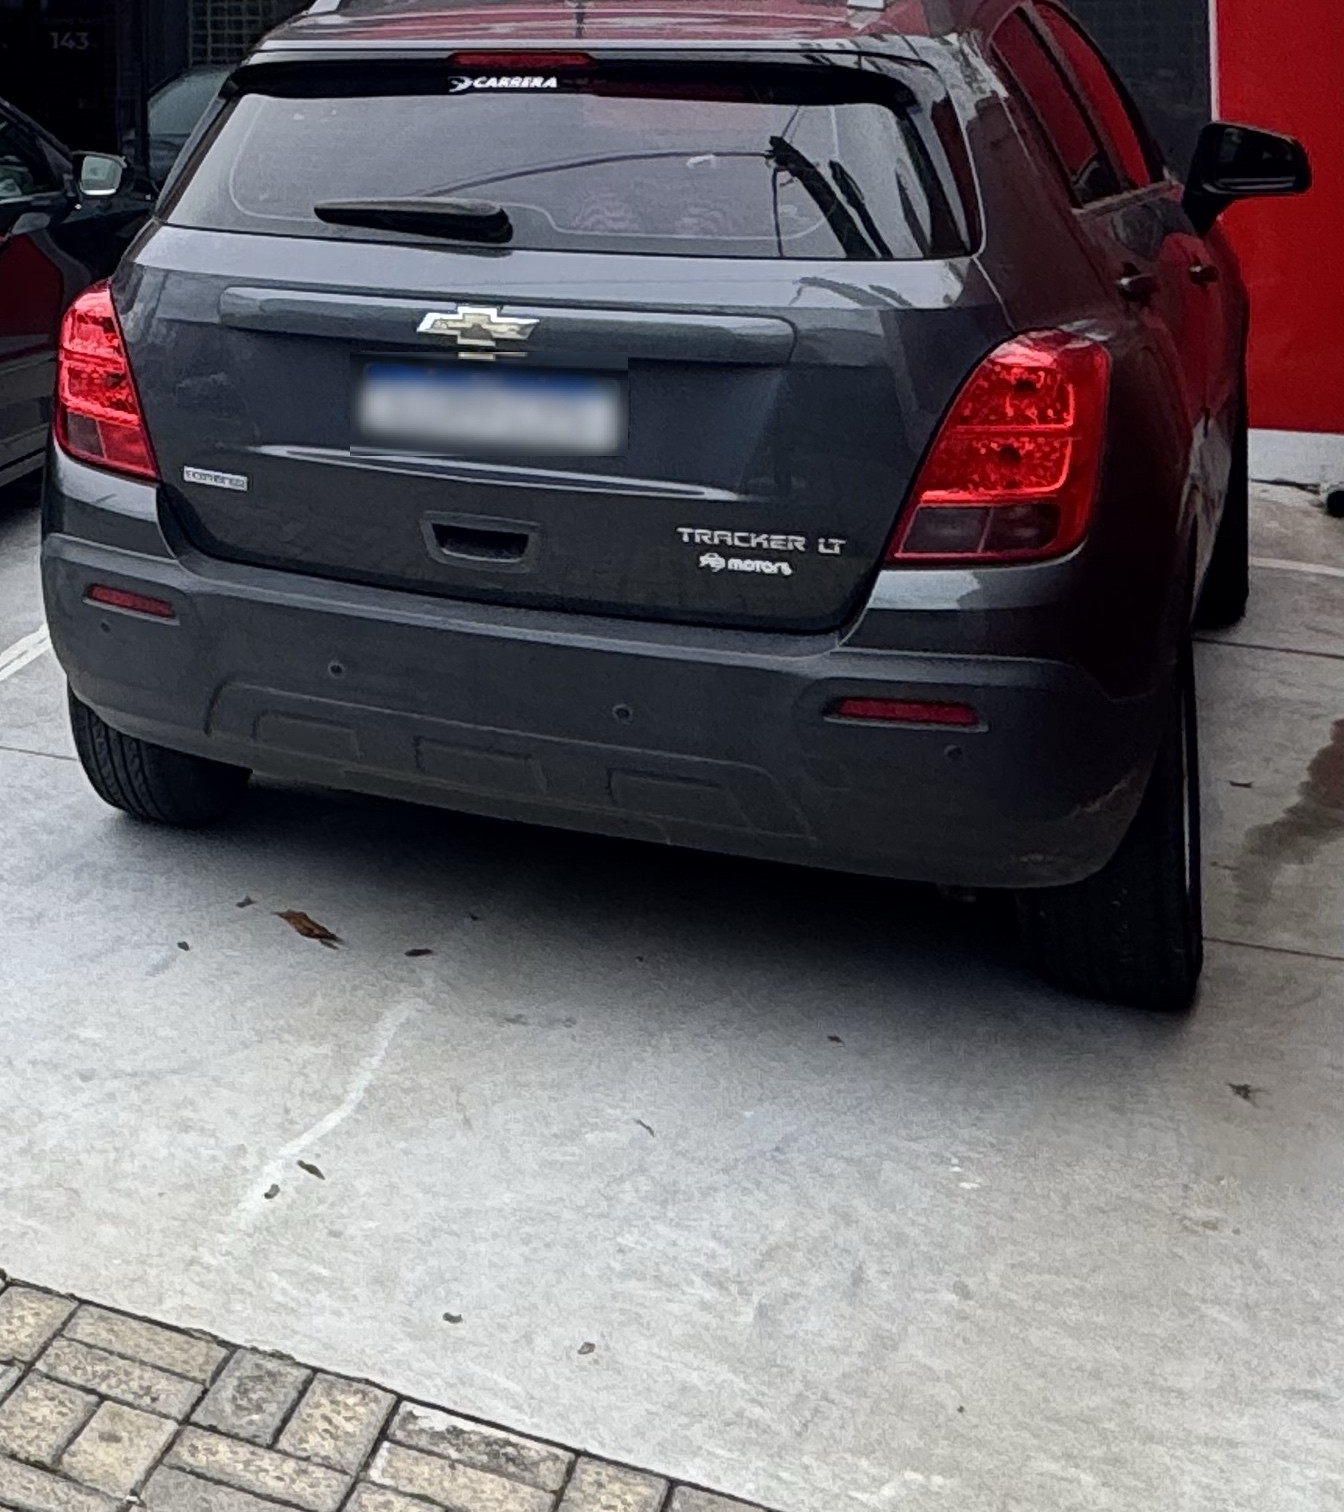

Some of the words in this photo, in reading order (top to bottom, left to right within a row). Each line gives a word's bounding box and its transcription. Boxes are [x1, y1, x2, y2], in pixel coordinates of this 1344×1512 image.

[49, 31, 90, 51] 143
[472, 75, 558, 89] CARRERA
[676, 527, 806, 551] TRACKER
[818, 537, 847, 555] LT
